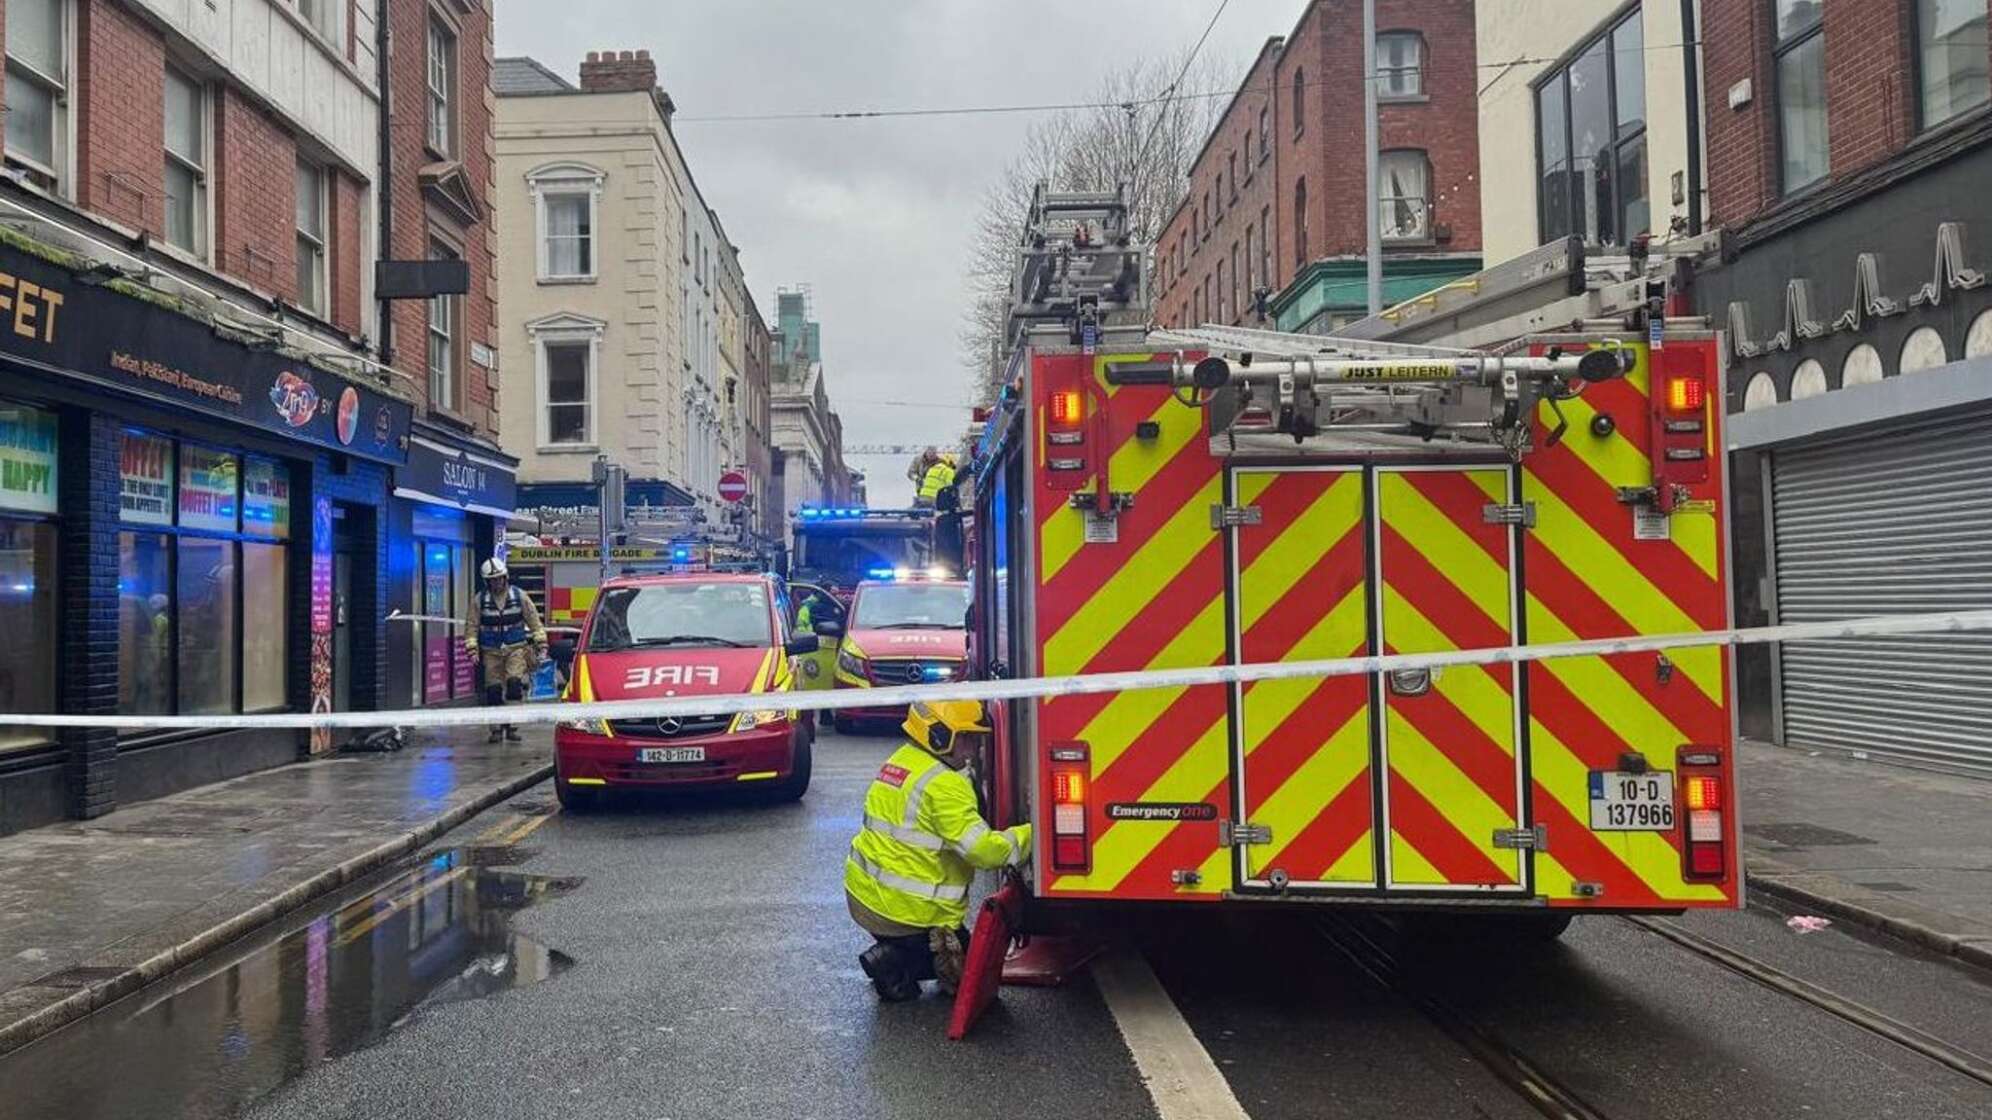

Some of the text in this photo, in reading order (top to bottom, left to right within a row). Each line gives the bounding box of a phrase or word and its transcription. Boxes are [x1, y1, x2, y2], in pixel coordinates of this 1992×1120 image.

[1345, 366, 1384, 379] JUST
[1388, 365, 1449, 378] LEITERN
[443, 462, 476, 489] SALON
[521, 550, 642, 558] DUBLIN FIRE BIGADE
[1619, 779, 1659, 801] 10-D
[1112, 805, 1181, 819] Emergency
[1606, 803, 1674, 826] 137966
